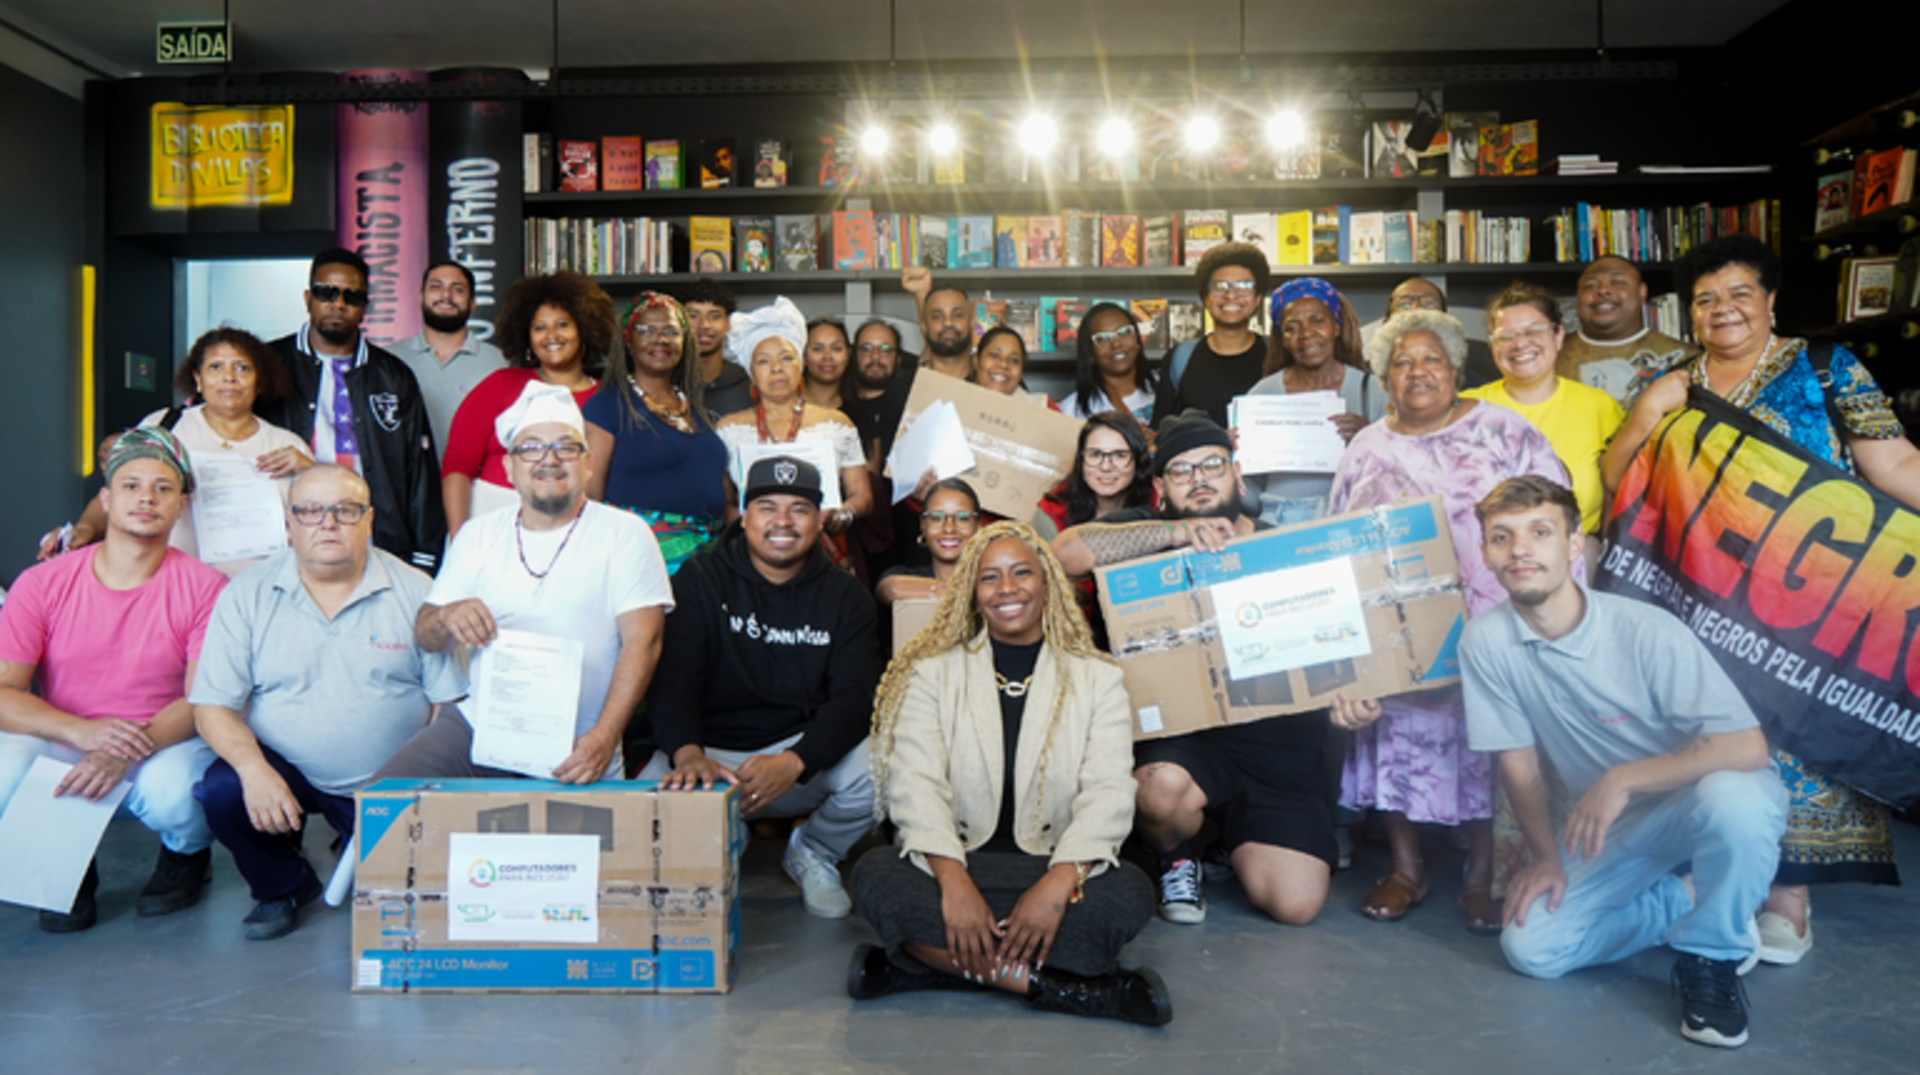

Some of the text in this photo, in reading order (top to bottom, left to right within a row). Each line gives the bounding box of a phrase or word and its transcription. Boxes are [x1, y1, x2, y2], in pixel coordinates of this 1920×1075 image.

[159, 28, 227, 59] SAÍDA
[1609, 406, 1920, 702] NEGR
[1604, 544, 1634, 577] DE
[1689, 602, 1769, 665] NEGROS
[1763, 646, 1822, 695] PELA
[1817, 673, 1920, 748] IGUALDAD
[365, 806, 390, 816] AOC
[434, 958, 460, 971] LCD
[461, 957, 510, 971] Monitor
